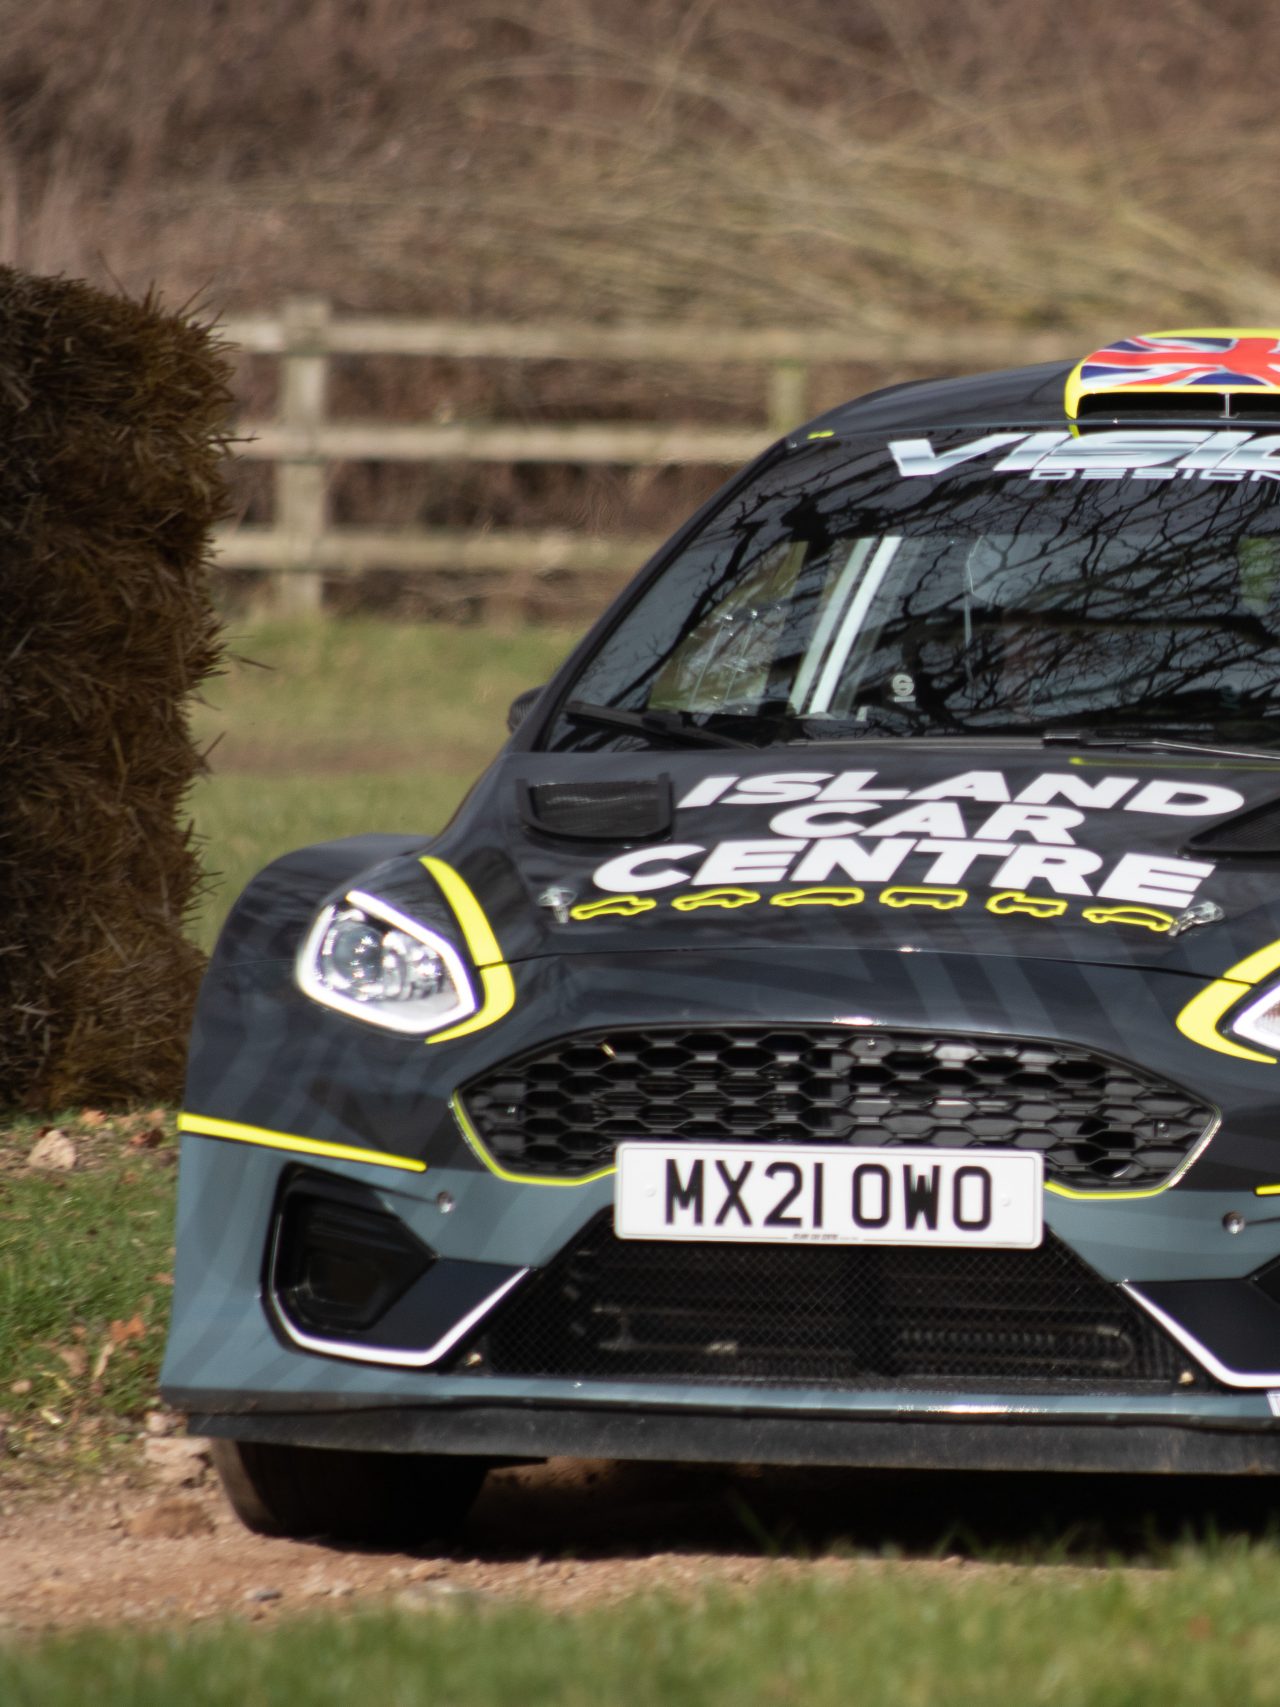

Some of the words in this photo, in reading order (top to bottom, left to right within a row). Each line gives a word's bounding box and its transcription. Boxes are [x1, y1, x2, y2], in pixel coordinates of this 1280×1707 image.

[678, 771, 1244, 816] ISLAND
[769, 801, 1085, 844] CAR
[592, 838, 1215, 908] CENTRE
[664, 1158, 824, 1228] MX21
[851, 1163, 992, 1231] OWO
